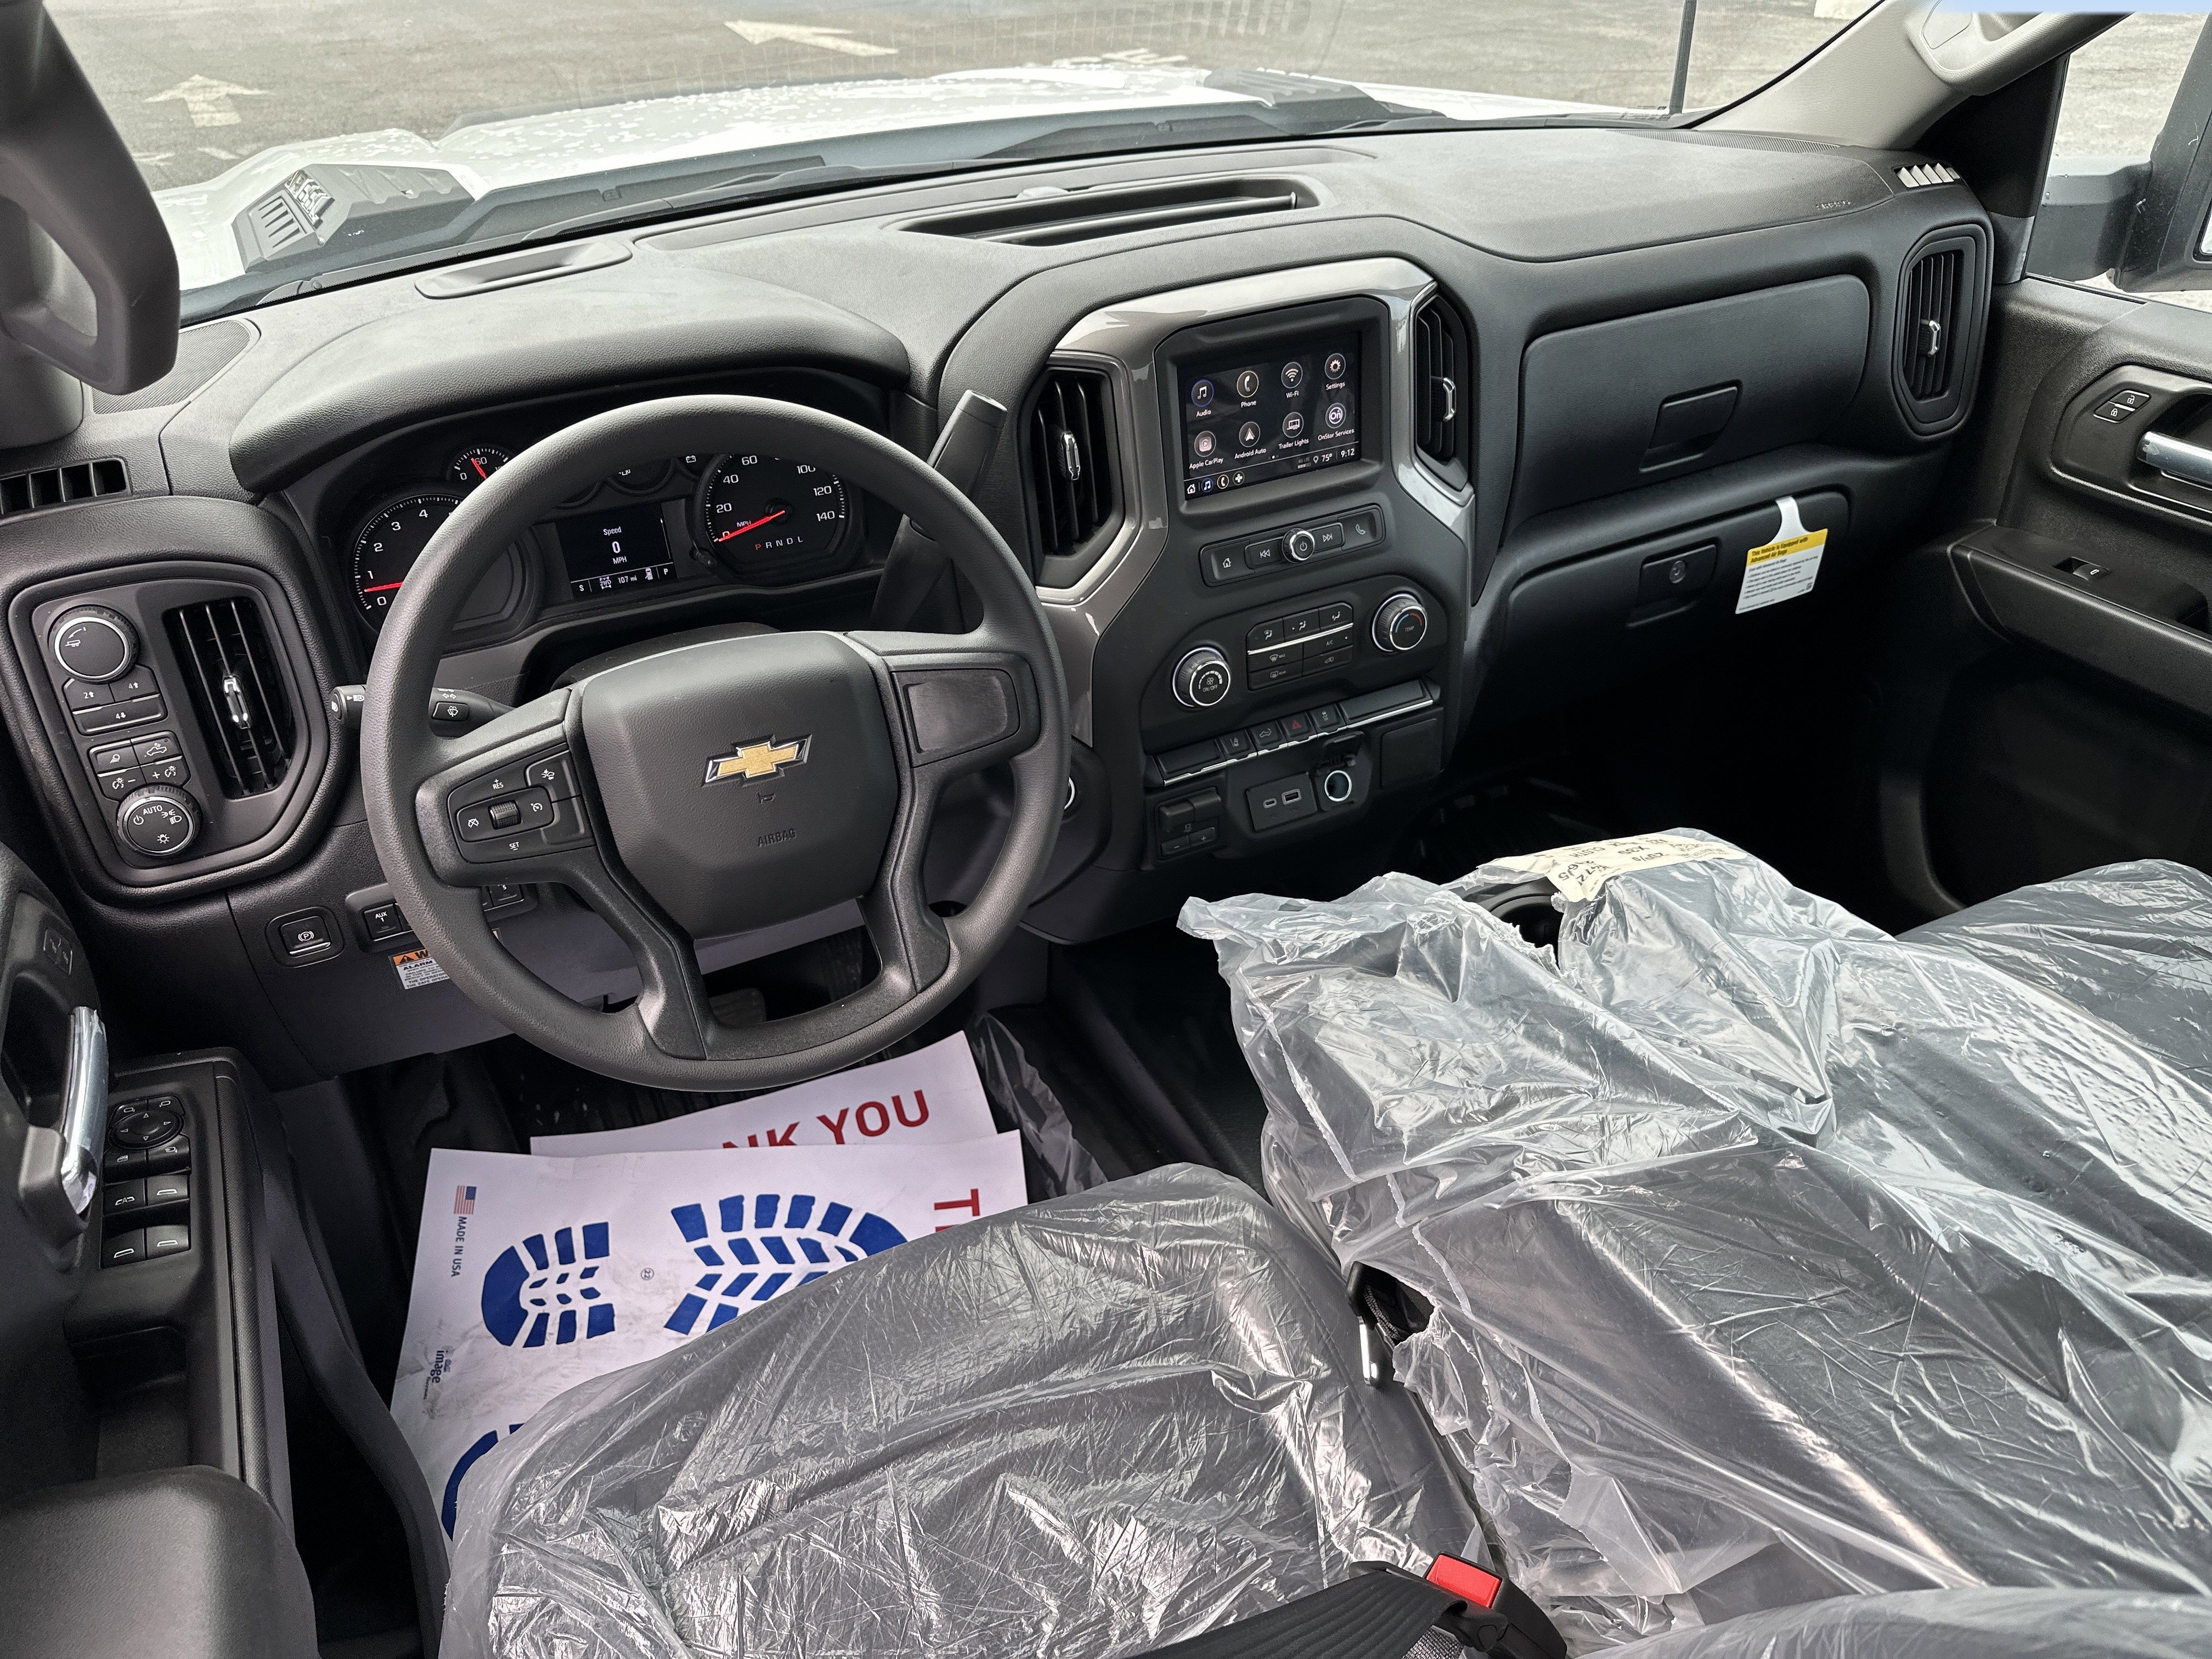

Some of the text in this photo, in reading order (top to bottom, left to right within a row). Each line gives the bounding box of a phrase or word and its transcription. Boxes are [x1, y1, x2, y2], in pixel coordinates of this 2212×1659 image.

[1196, 409, 1211, 417] Audio
[1335, 428, 1355, 437] Services
[1278, 438, 1309, 450] Trailer Lights
[1234, 451, 1254, 459] Android
[1341, 448, 1355, 458] 9:12
[742, 455, 758, 465] 60
[1189, 457, 1224, 470] Apple CarPlay
[723, 474, 739, 484] 40
[813, 486, 832, 496] 120
[419, 509, 428, 518] 4
[716, 503, 732, 514] 20
[816, 511, 835, 521] 140
[391, 521, 401, 531] 3
[603, 526, 622, 536] Speed
[374, 543, 383, 552] 2
[612, 541, 620, 554] 0
[612, 556, 627, 565] MPH
[368, 571, 374, 579] 1
[377, 596, 387, 606] 0
[143, 805, 163, 815] AUTO
[758, 828, 796, 847] AIRBAG
[403, 960, 433, 970] ALARM
[817, 1089, 929, 1146] YOU
[451, 1216, 467, 1277] MADE IN USA
[430, 1350, 444, 1384] image
